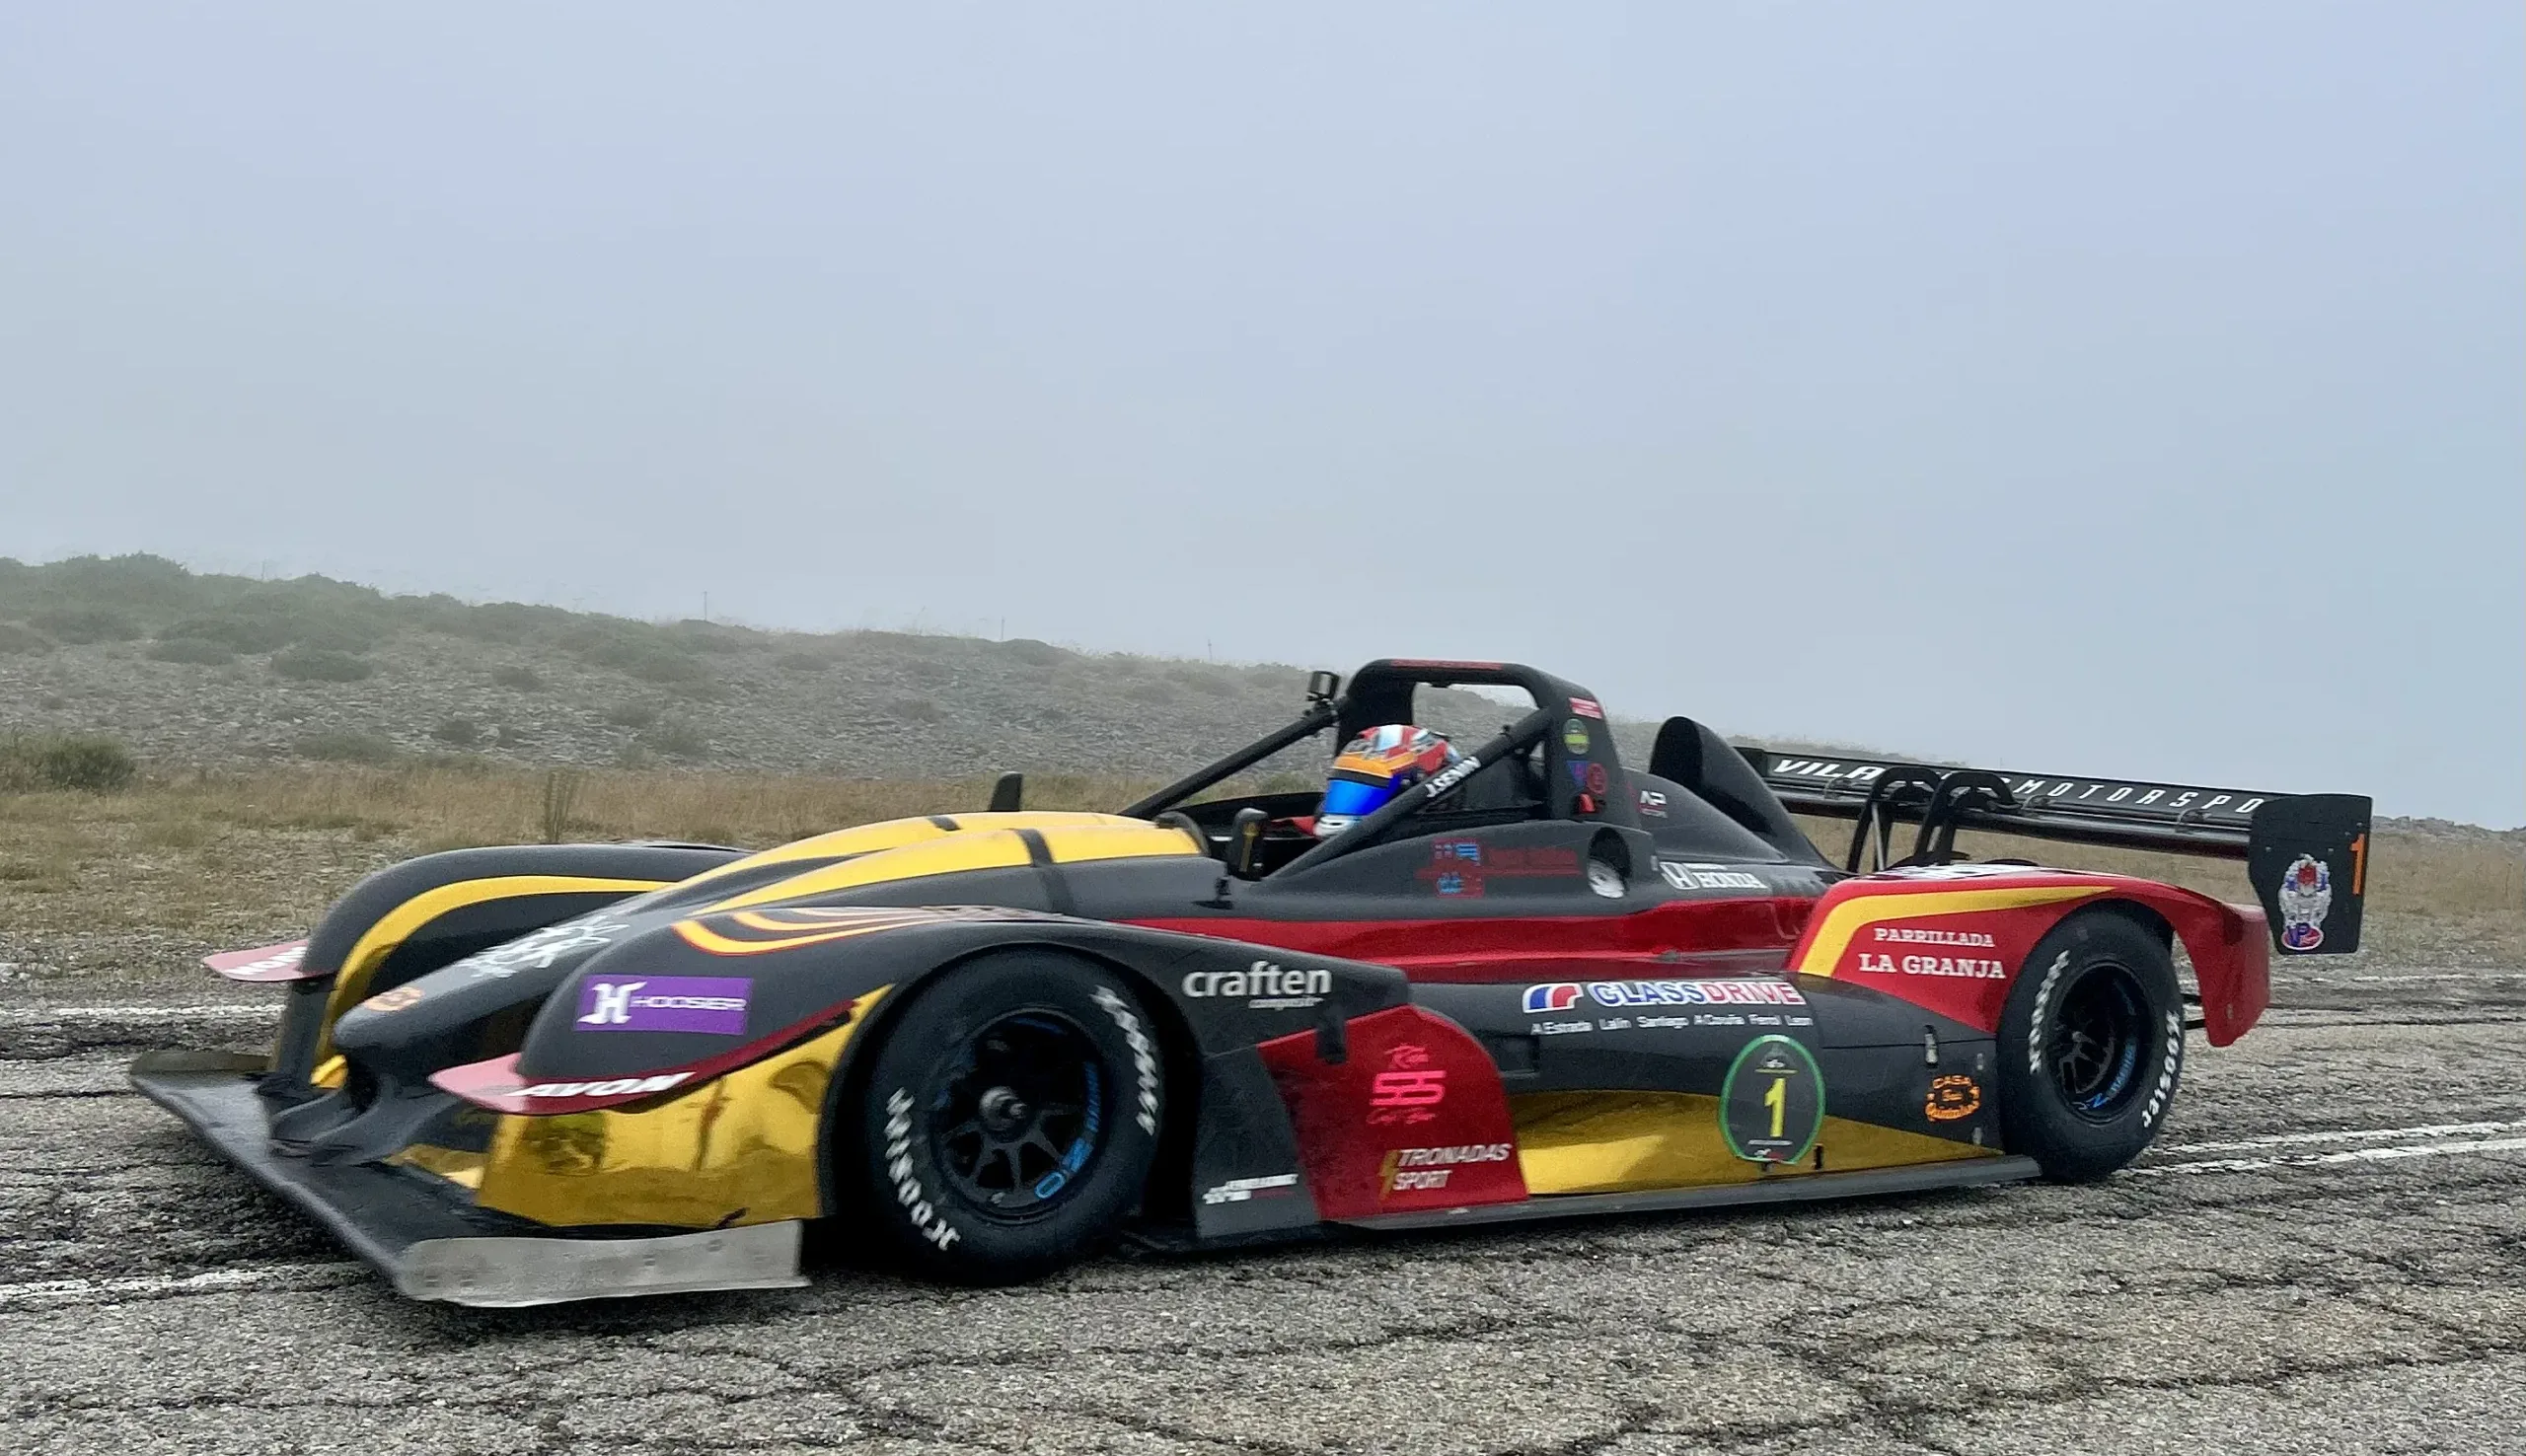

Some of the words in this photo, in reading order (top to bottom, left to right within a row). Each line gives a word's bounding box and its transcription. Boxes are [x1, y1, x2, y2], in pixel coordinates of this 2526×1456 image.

[2348, 833, 2366, 896] 1
[1692, 871, 1769, 889] HONDA
[1873, 927, 1996, 948] PARRILLADA
[1181, 960, 1333, 998] craften
[1858, 953, 1897, 974] LA
[1900, 954, 2007, 980] GRANJA
[630, 995, 748, 1012] HOOSIER
[1587, 981, 1807, 1007] GLASSDRIVE
[502, 1071, 698, 1098] AVON
[1763, 1077, 1786, 1137] 1
[1396, 1142, 1514, 1168] TRONADAS
[1392, 1169, 1453, 1192] SPORT
